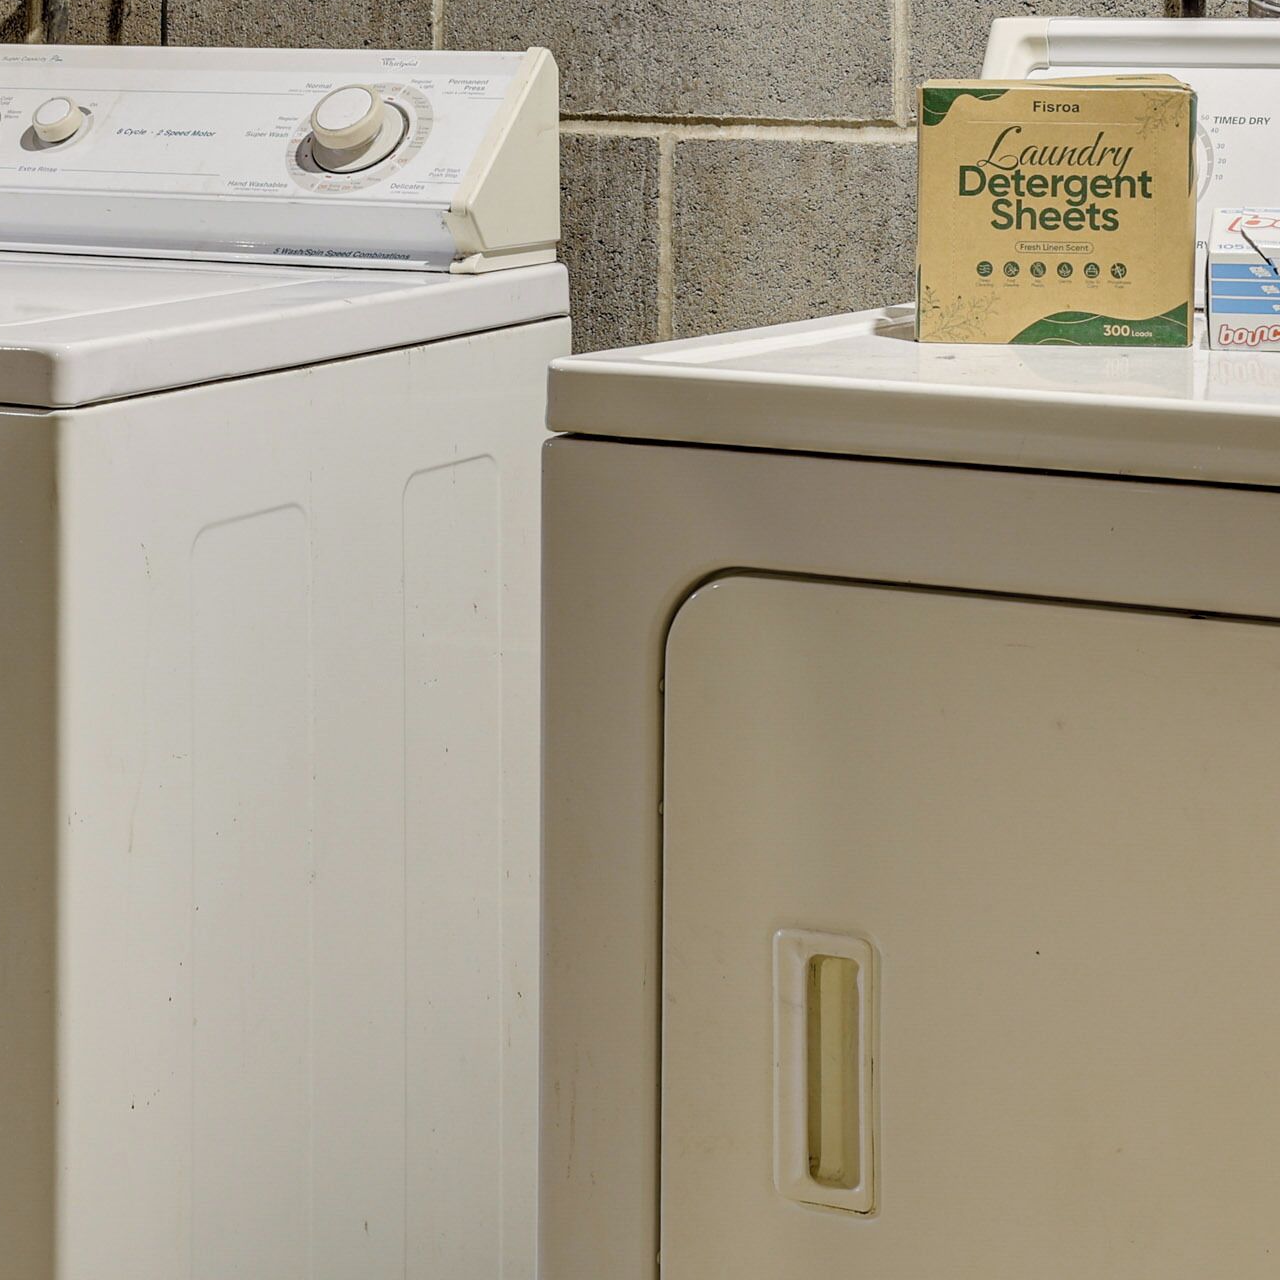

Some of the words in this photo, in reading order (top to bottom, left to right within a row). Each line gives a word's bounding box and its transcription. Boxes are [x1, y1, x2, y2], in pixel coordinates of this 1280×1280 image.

[382, 60, 419, 68] Whirlpool
[1033, 100, 1080, 113] Fisroa
[1214, 116, 1246, 125] TIMED
[1249, 116, 1271, 125] DRY
[124, 128, 147, 136] Cycle
[164, 129, 190, 137] Speed
[977, 126, 1134, 180] Laundry
[249, 180, 288, 188] Washables
[959, 165, 1152, 207] Detergent
[991, 198, 1120, 232] Sheets
[1020, 243, 1041, 251] Fresh
[1043, 243, 1064, 251] Linen
[1066, 244, 1089, 252] Scent
[324, 249, 352, 258] Speed
[353, 251, 410, 260] Combinations
[1103, 325, 1130, 337] 300
